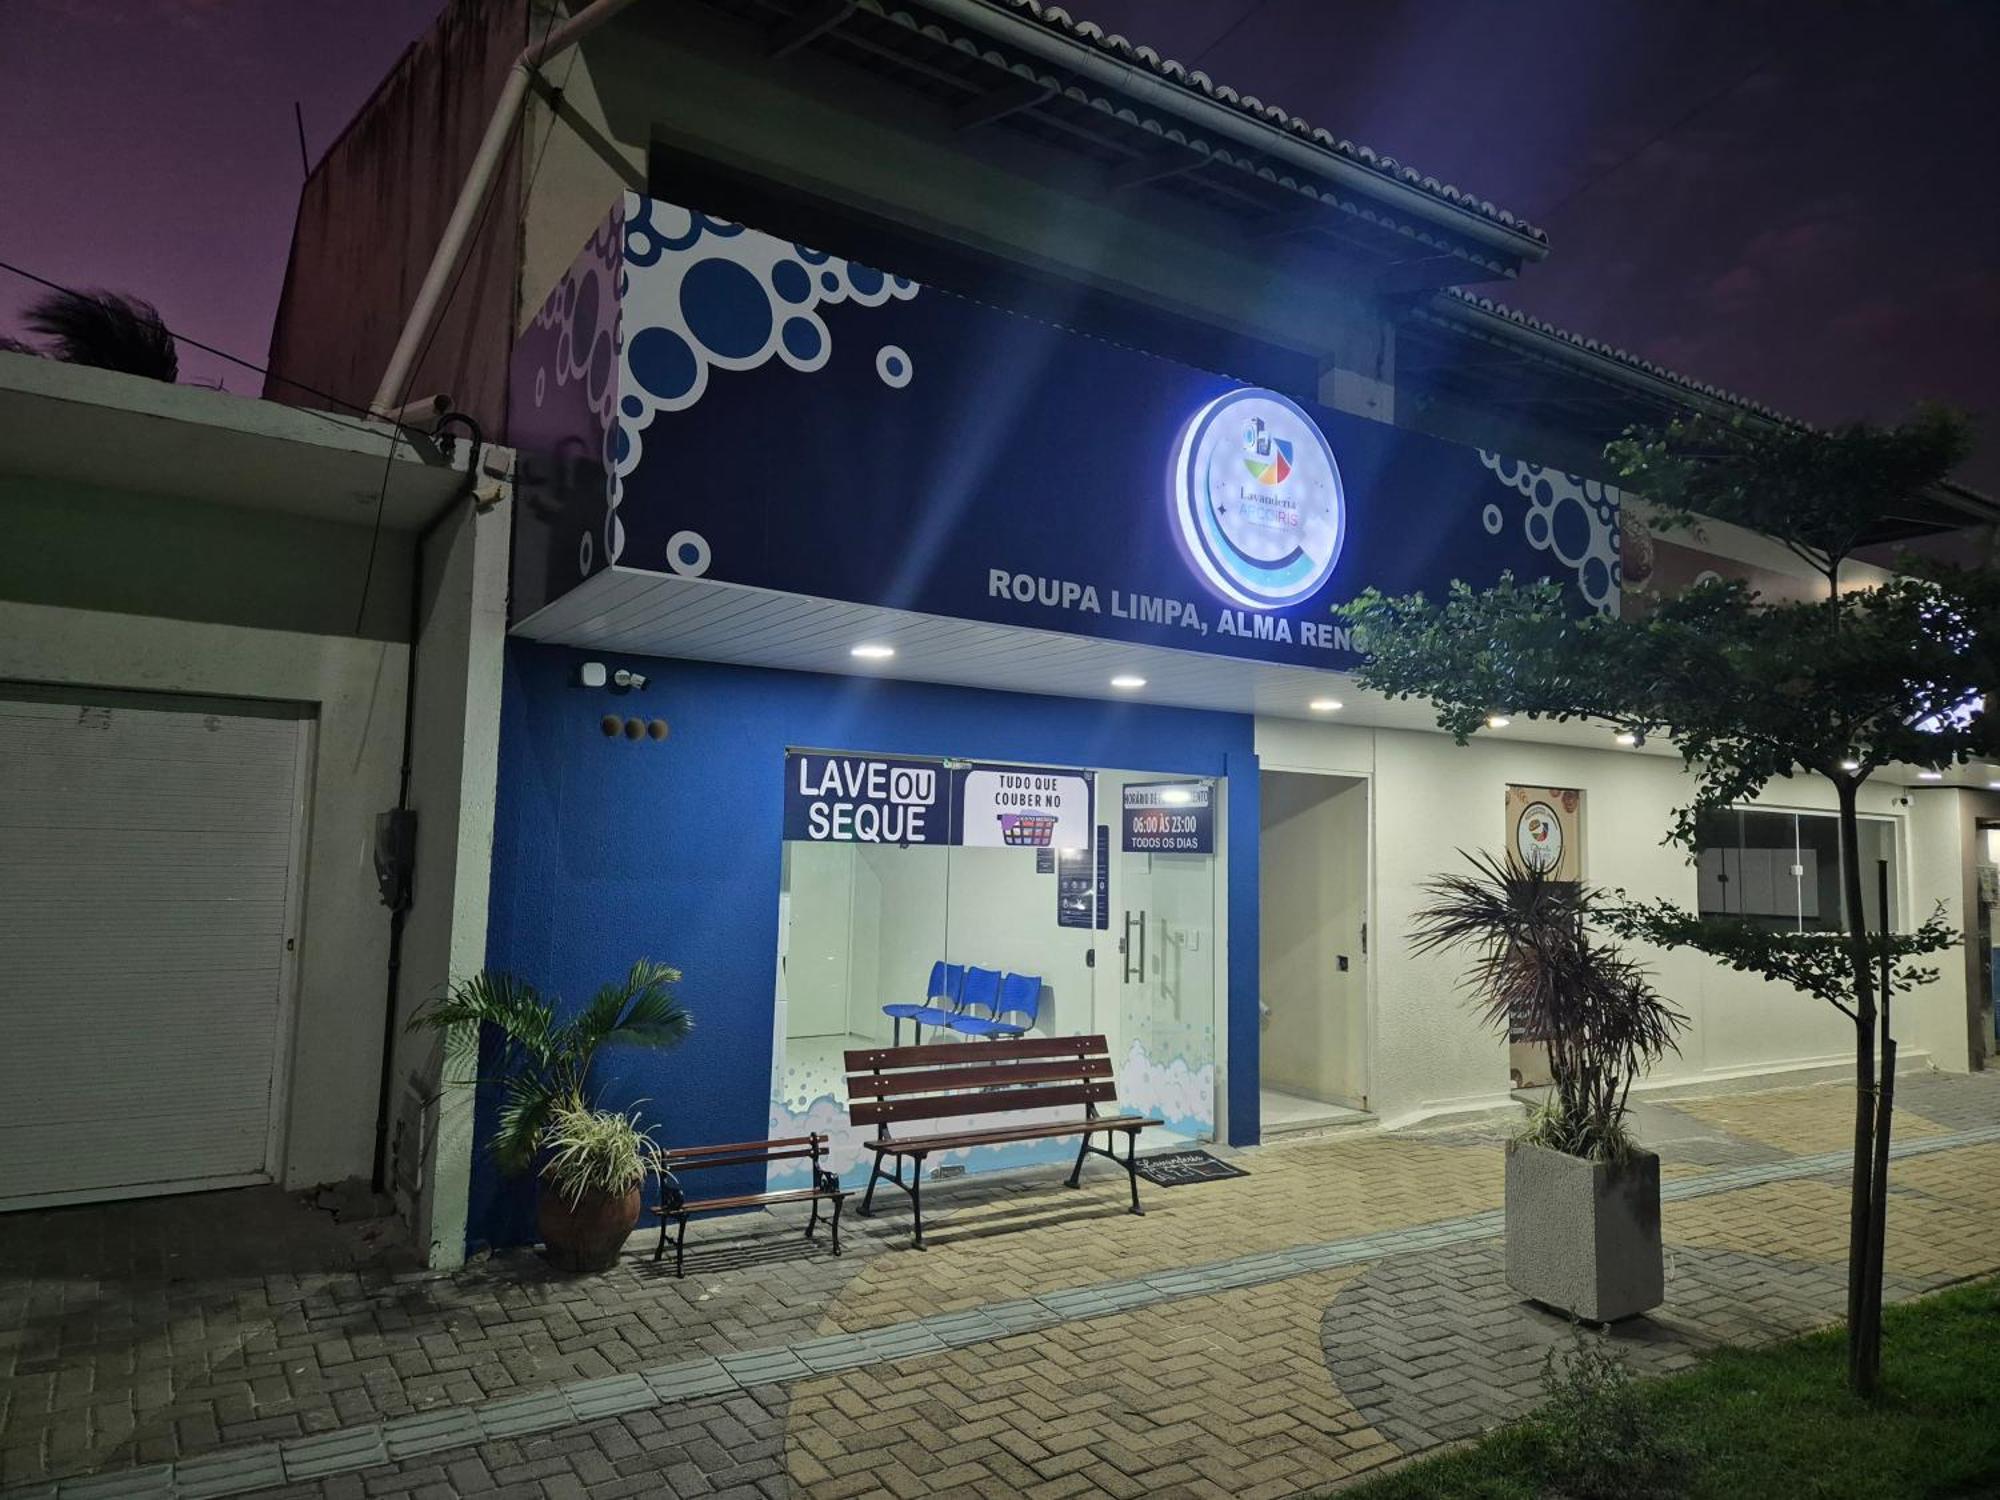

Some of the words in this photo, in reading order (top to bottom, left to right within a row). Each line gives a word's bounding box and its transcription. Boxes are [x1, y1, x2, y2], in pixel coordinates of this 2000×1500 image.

[1240, 486, 1297, 509] Lavanderia
[988, 568, 1101, 613] ROUPA
[1110, 590, 1208, 636] LIMPA,
[1216, 609, 1292, 644] ALMA
[800, 758, 888, 799] LAVE
[894, 772, 932, 801] OU
[999, 775, 1031, 790] TUDO
[1034, 777, 1057, 791] QUE
[995, 792, 1042, 807] COUBER
[1045, 795, 1061, 808] NO
[808, 802, 926, 843] SEQUE
[1133, 816, 1158, 833] 06:00
[1171, 815, 1197, 833] 23:00
[1131, 837, 1160, 848] TODOS
[1162, 837, 1175, 848] OS
[1176, 837, 1198, 849] DIAS
